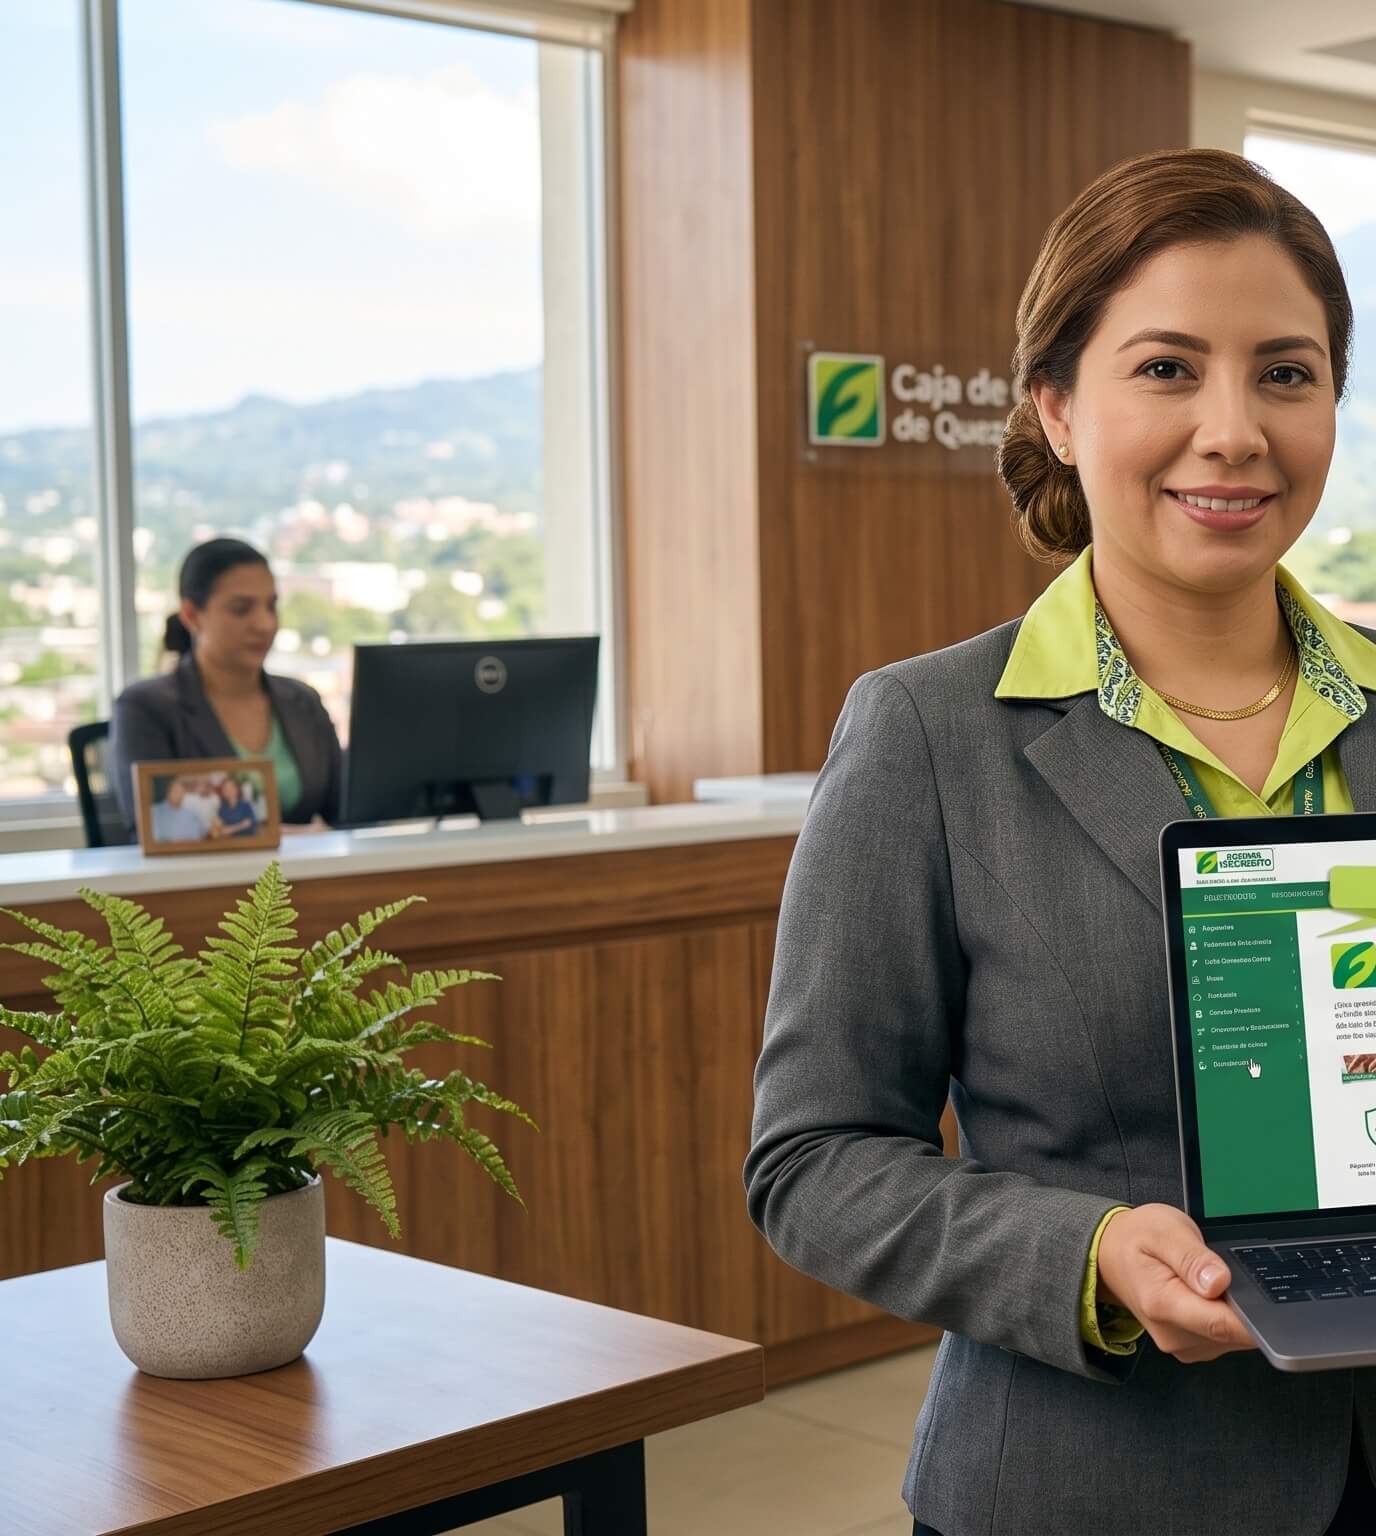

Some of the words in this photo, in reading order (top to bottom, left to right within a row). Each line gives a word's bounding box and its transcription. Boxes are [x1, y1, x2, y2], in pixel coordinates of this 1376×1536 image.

[891, 363, 962, 411] Caja
[967, 368, 1009, 406] de
[892, 408, 930, 443] de
